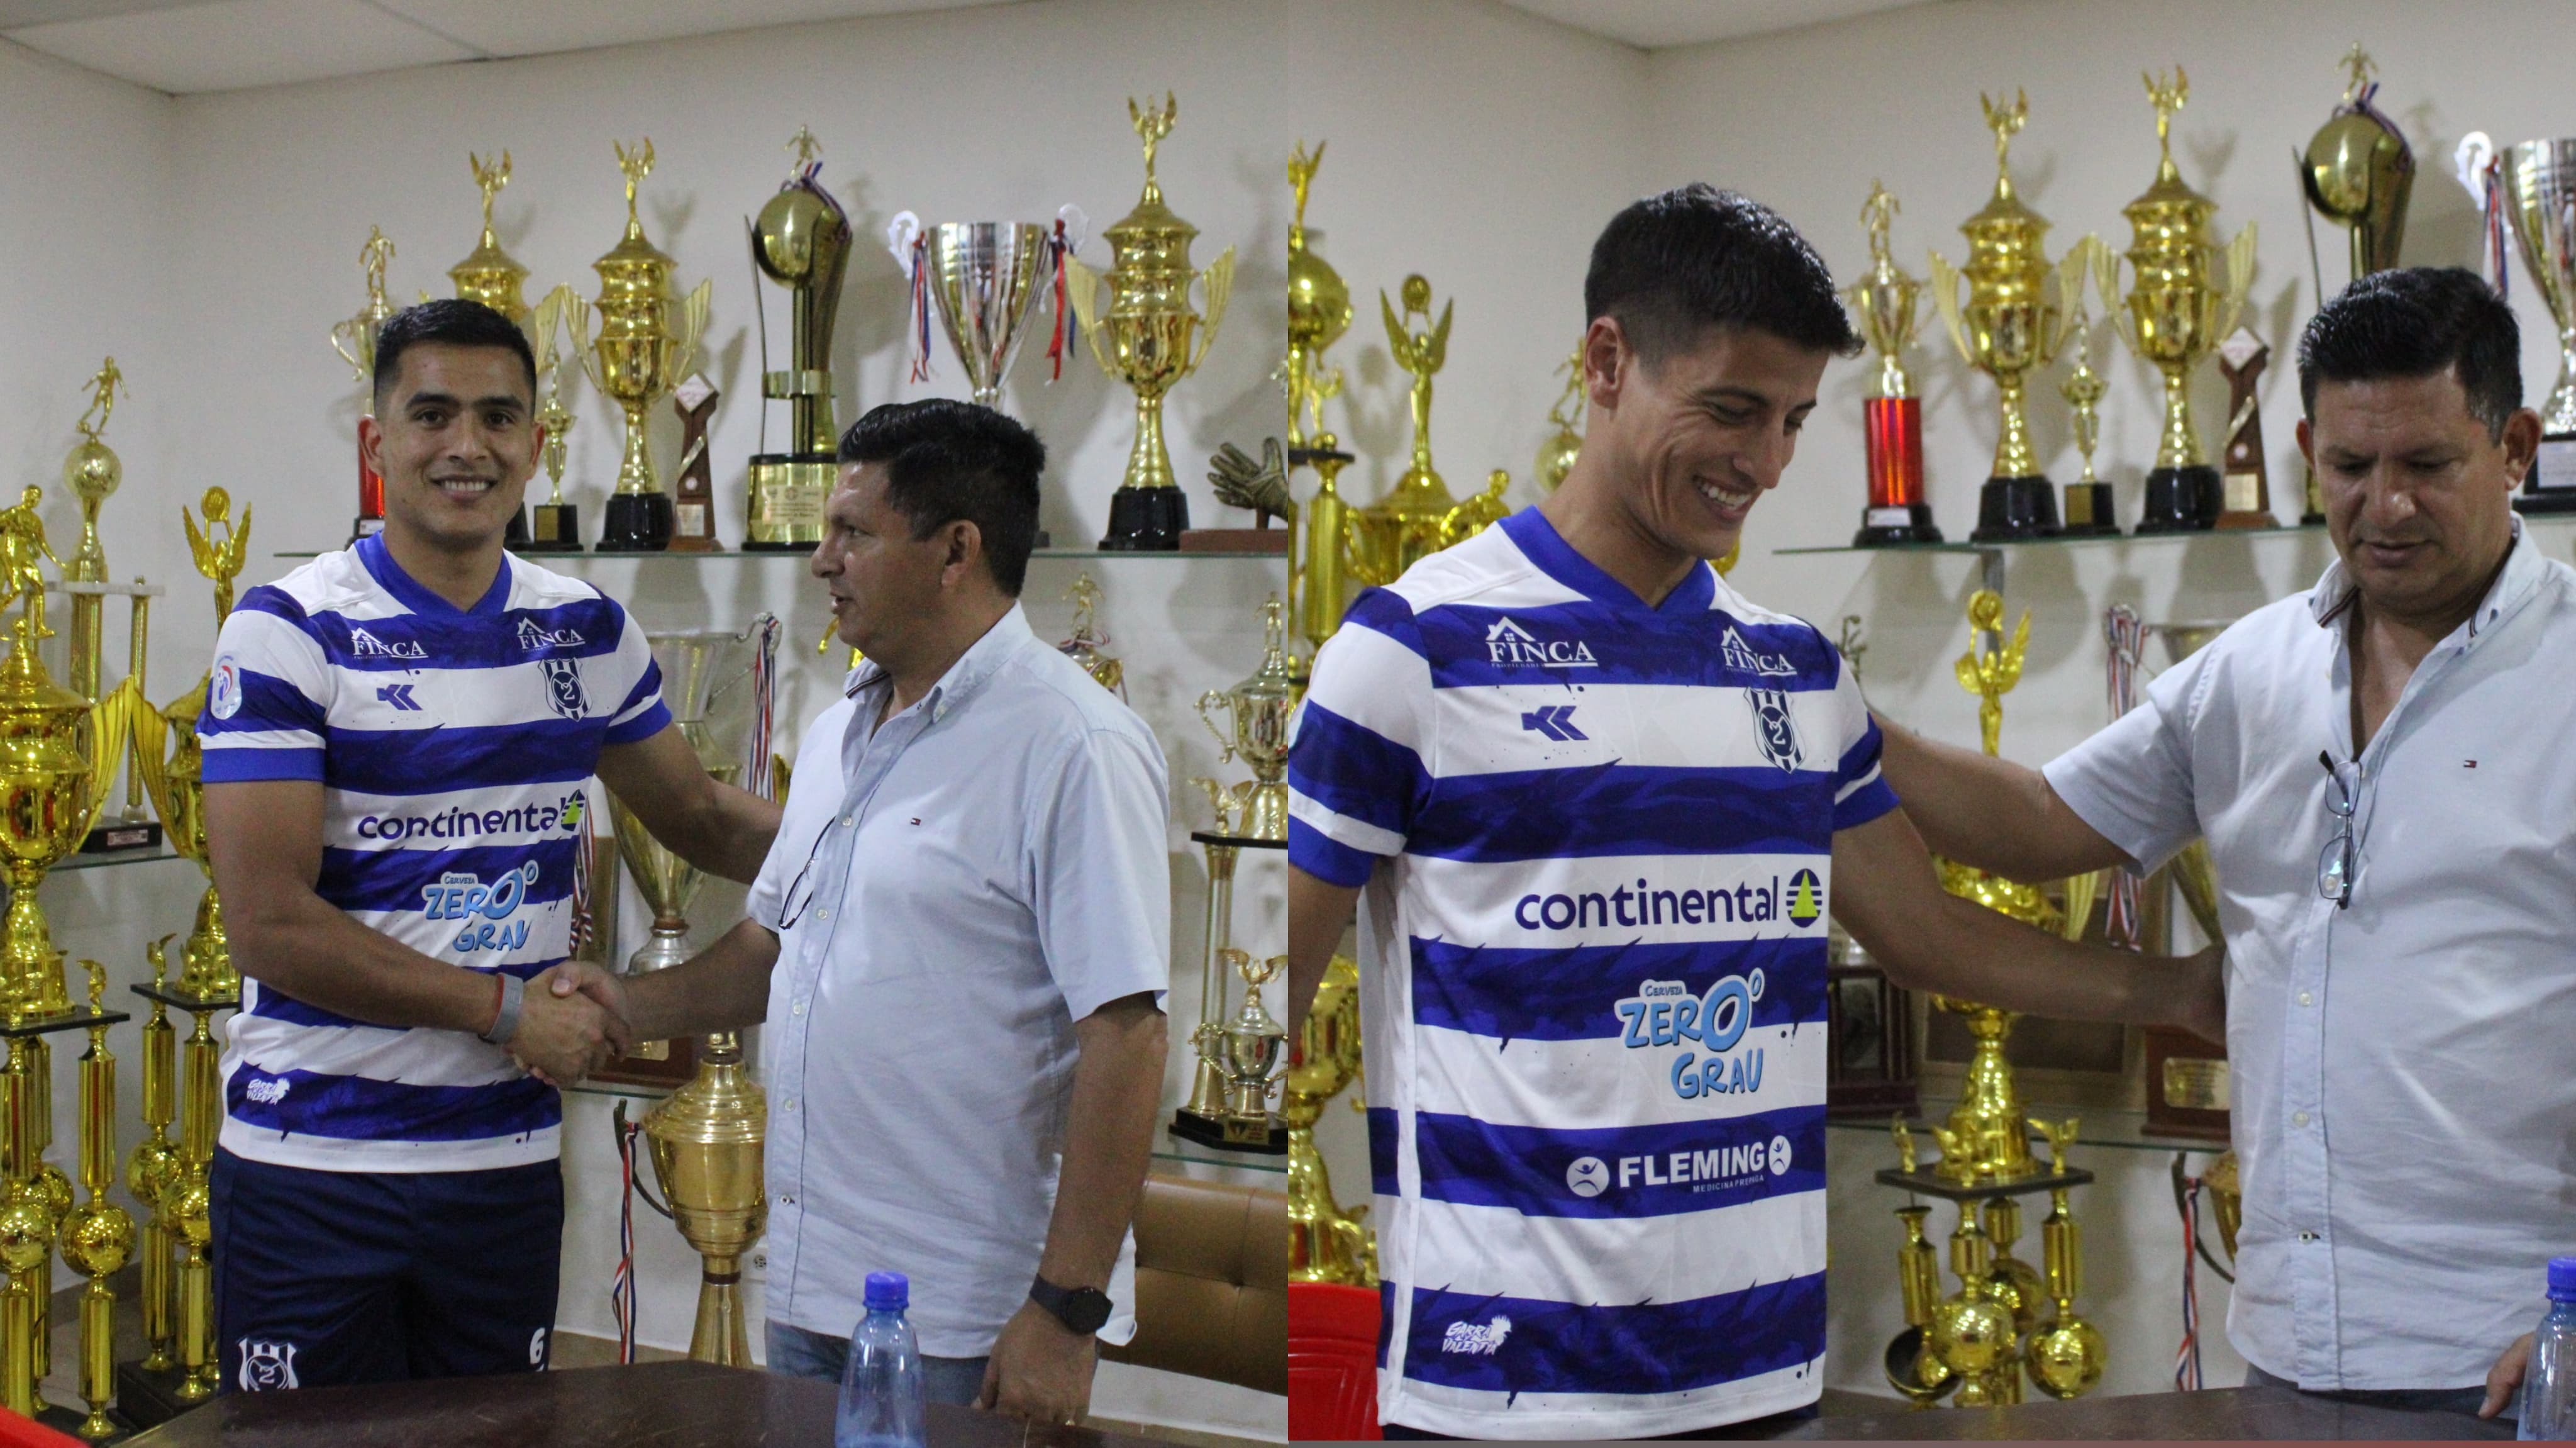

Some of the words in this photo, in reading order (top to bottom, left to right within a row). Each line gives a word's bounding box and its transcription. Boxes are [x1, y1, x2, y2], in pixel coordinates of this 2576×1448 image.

[352, 640, 427, 655] FINCA
[518, 629, 584, 649] FINCA
[1485, 640, 1597, 662] FINCA
[1723, 648, 1796, 672] FINCA
[1514, 876, 1779, 930] continental
[1670, 1047, 1763, 1099] GRAU
[1619, 1142, 1765, 1188] FLEMING
[1692, 1181, 1734, 1193] MEDICINA
[530, 1327, 545, 1371] 6
